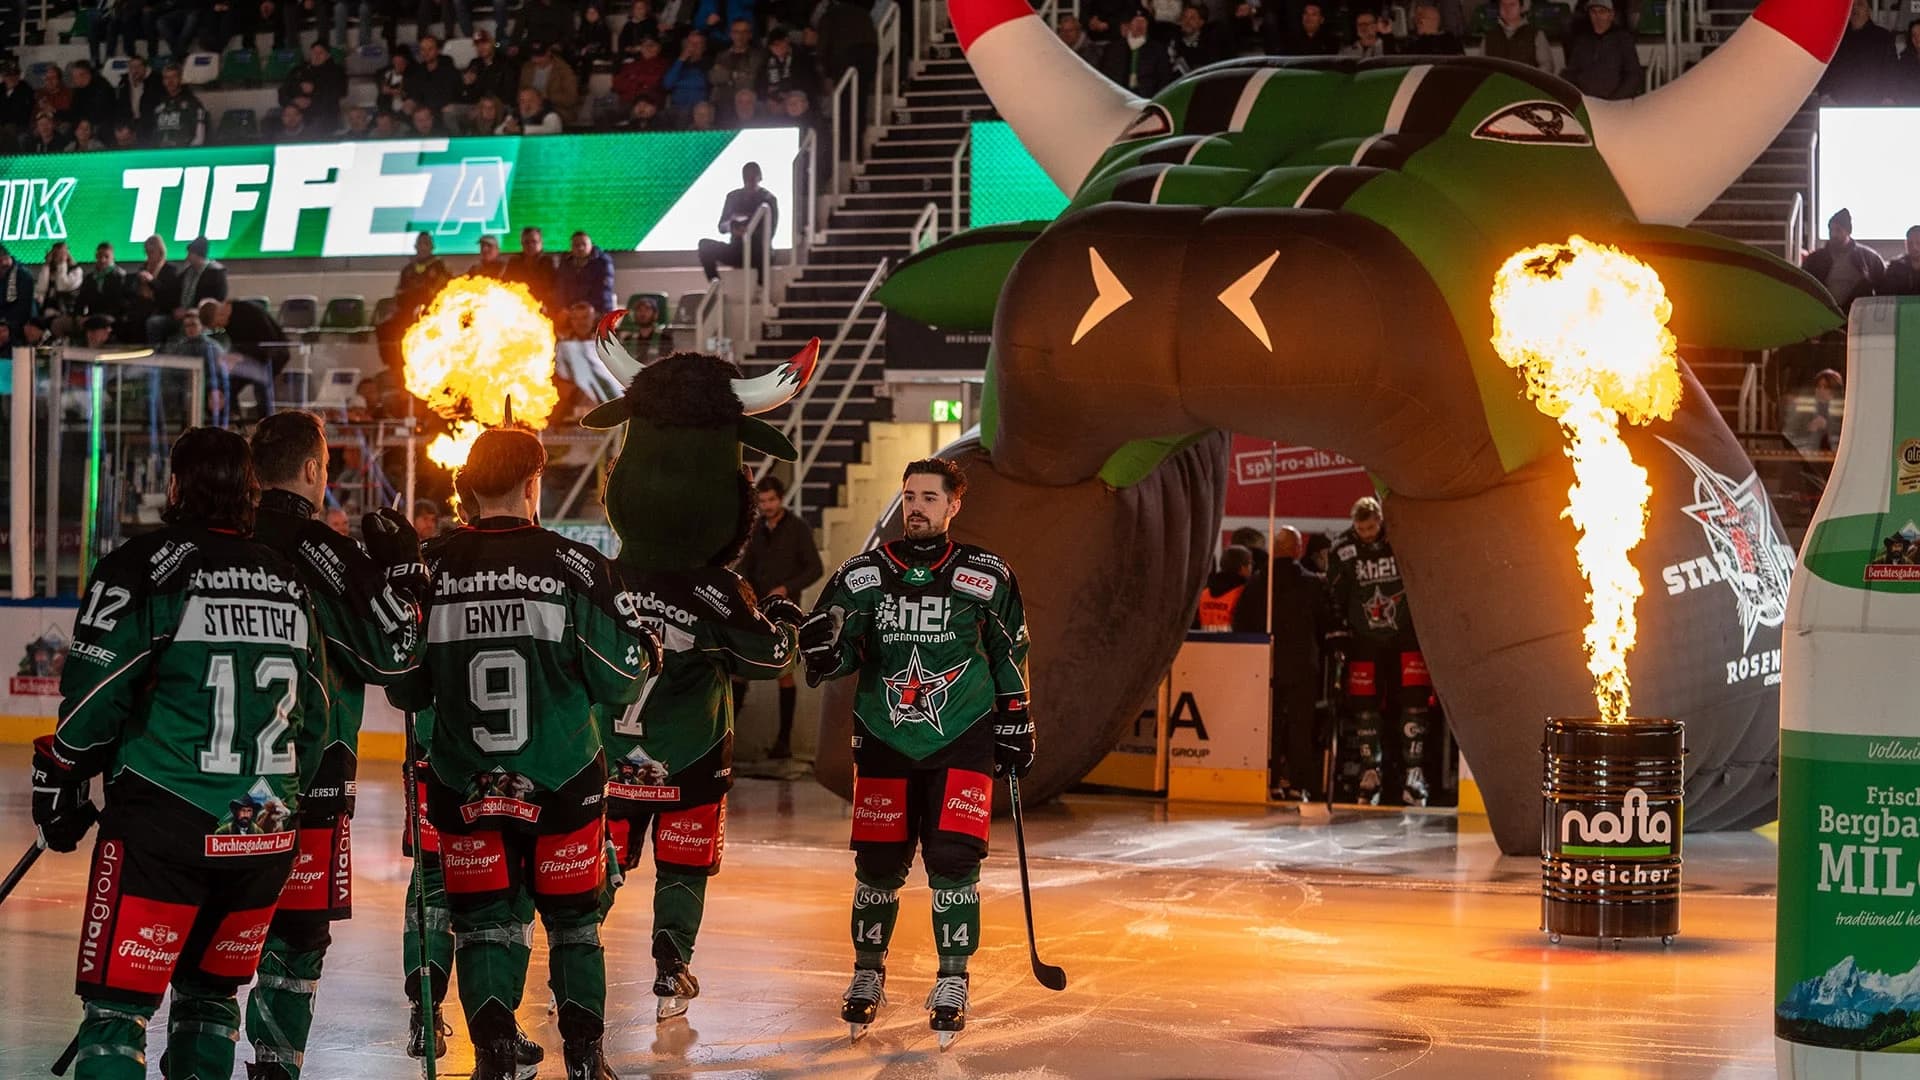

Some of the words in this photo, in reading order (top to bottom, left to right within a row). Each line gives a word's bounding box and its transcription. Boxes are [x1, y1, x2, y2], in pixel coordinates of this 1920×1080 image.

[0, 177, 78, 240] IK
[150, 541, 195, 581] HARTINGER
[301, 540, 346, 592] HARTINGER
[1868, 567, 1920, 580] Berchtesgaden
[851, 574, 878, 588] ROFA
[80, 580, 131, 632] 12
[465, 603, 525, 634] GNYP
[205, 603, 297, 642] STRETCH
[1726, 648, 1781, 685] ROSEN
[468, 650, 528, 752] 9
[200, 655, 298, 776] 12
[1171, 747, 1210, 758] GROUP
[604, 784, 657, 799] erchtesgadener
[657, 788, 675, 799] Land
[855, 807, 903, 822] Flötzinger
[947, 797, 989, 818] Flötzinge
[1818, 804, 1920, 844] Bergba
[212, 837, 275, 854] Berchtesgadener
[276, 834, 292, 848] Land
[660, 829, 712, 846] Flötzinger
[446, 854, 501, 868] Flötzinger
[540, 855, 597, 874] Flötzinger
[1817, 842, 1920, 897] MIL
[290, 869, 325, 884] inger
[1561, 862, 1672, 887] Speicher
[1836, 910, 1904, 926] traditionell
[856, 920, 883, 945] 14
[942, 923, 969, 947] 14
[118, 938, 180, 964] Flötzinge
